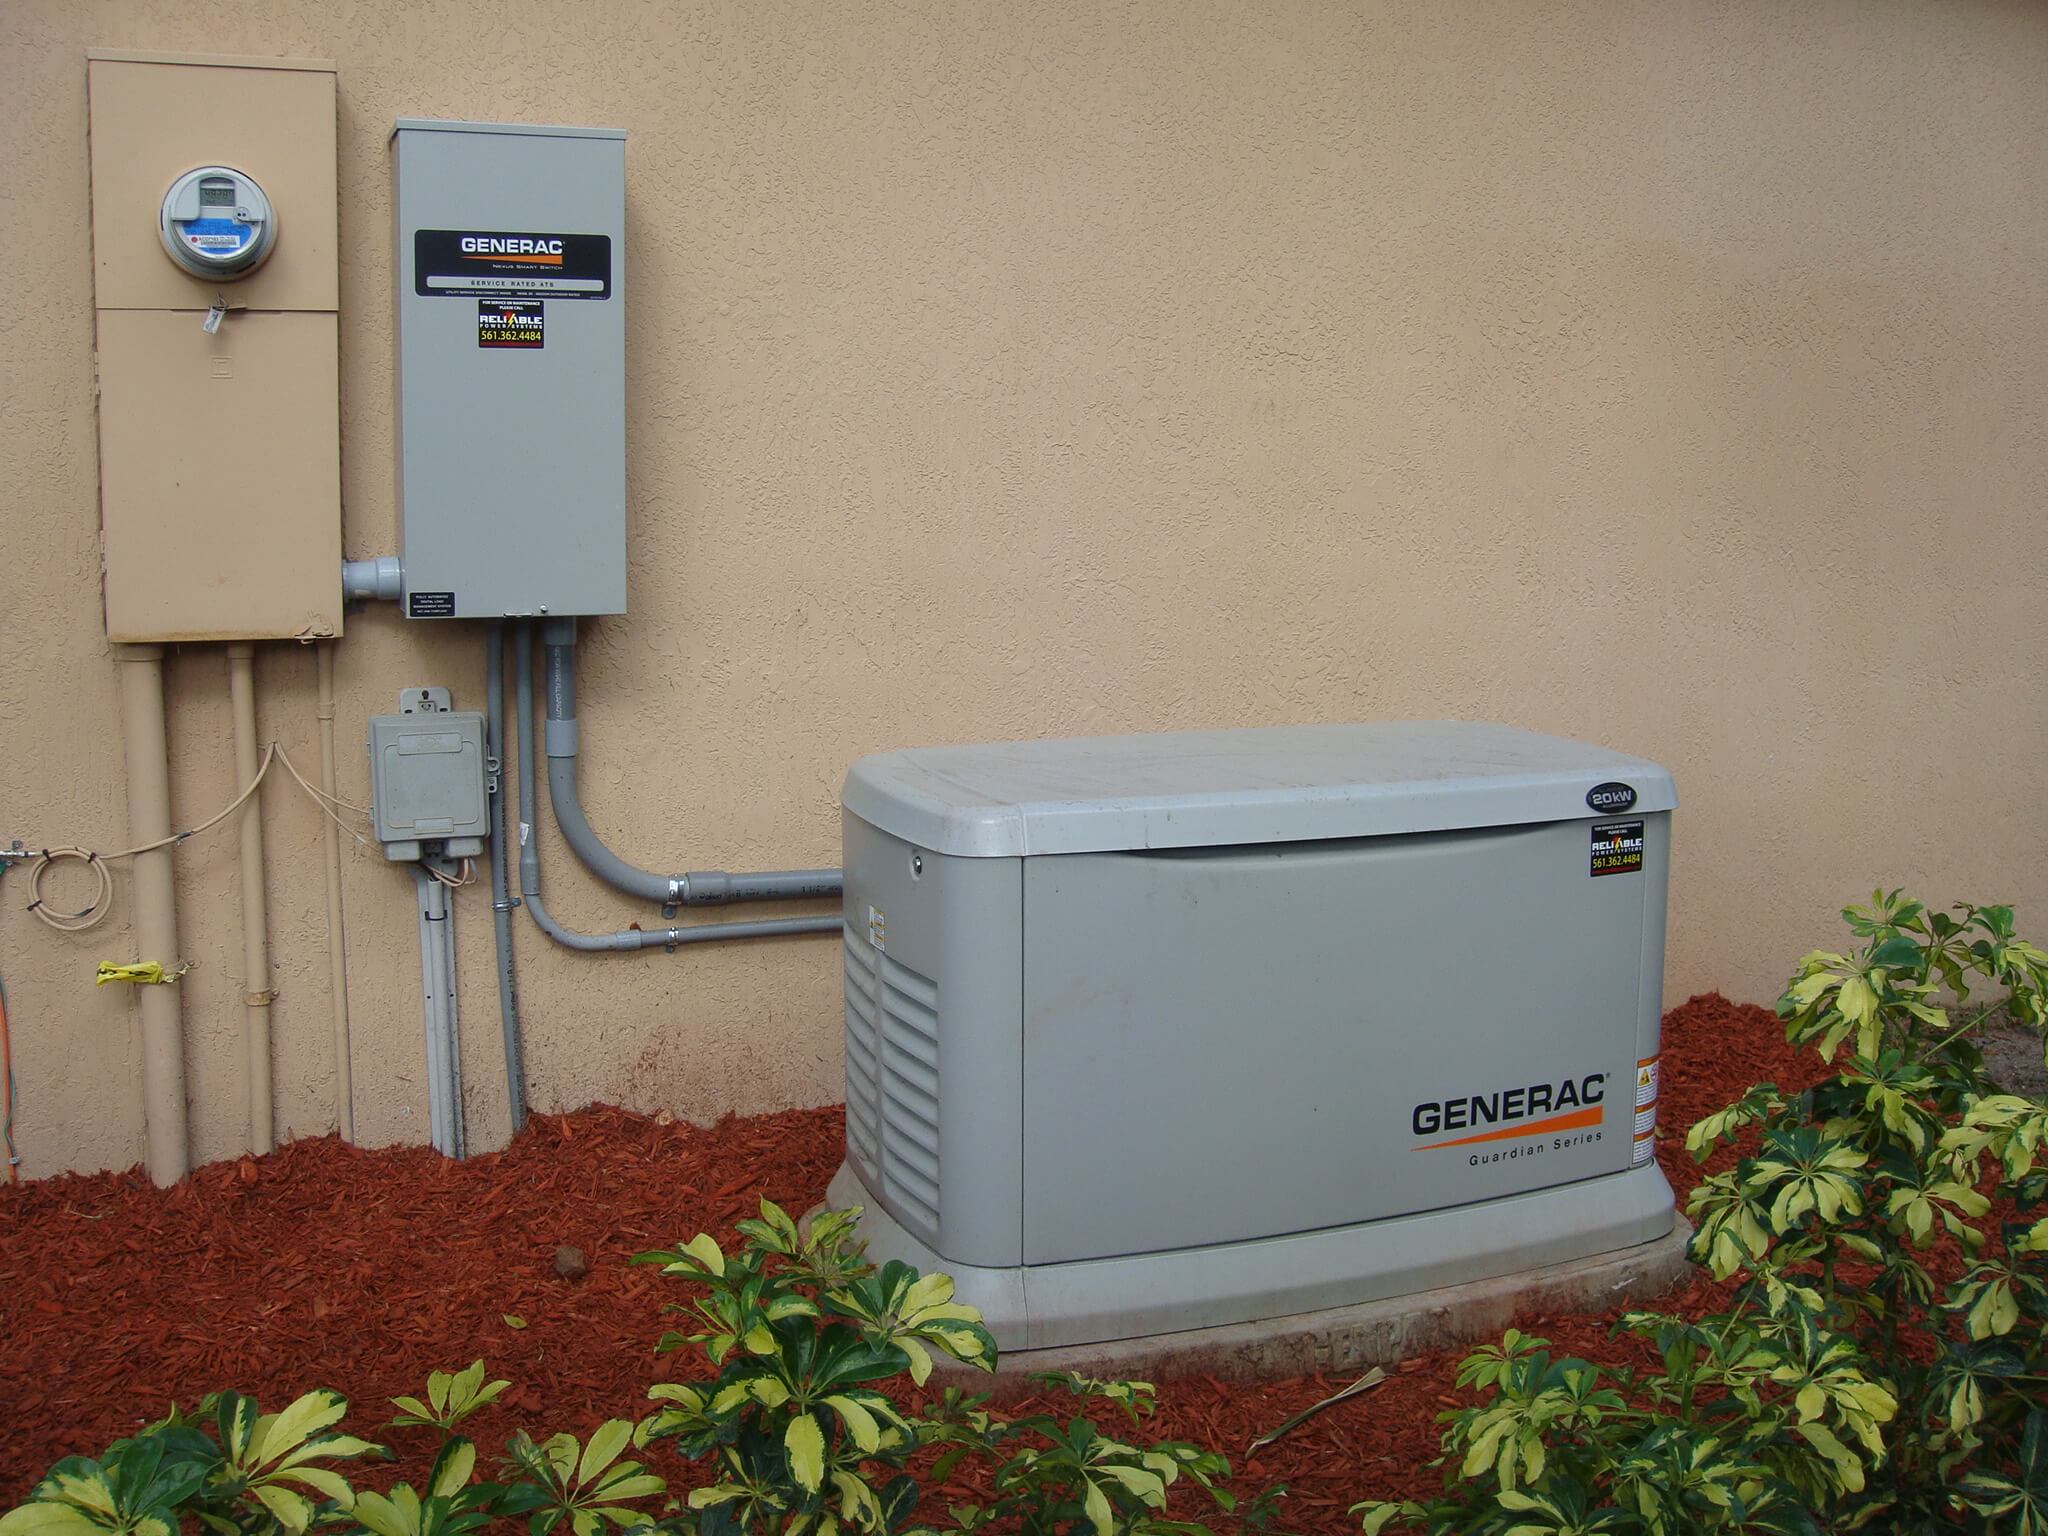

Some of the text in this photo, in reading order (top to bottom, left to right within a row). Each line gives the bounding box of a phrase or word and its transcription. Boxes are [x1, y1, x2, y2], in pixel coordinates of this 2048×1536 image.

[461, 237, 563, 255] GENERAC
[470, 280, 506, 288] SERVICE
[479, 314, 543, 325] RELIABLE
[481, 330, 541, 341] 561.362.4484
[1592, 790, 1632, 805] 20kW
[1591, 838, 1643, 851] RELIABLE
[1592, 853, 1641, 869] 561.362.4484
[1412, 1073, 1605, 1135] GENERAC
[1469, 1130, 1603, 1166] Guardian Series
